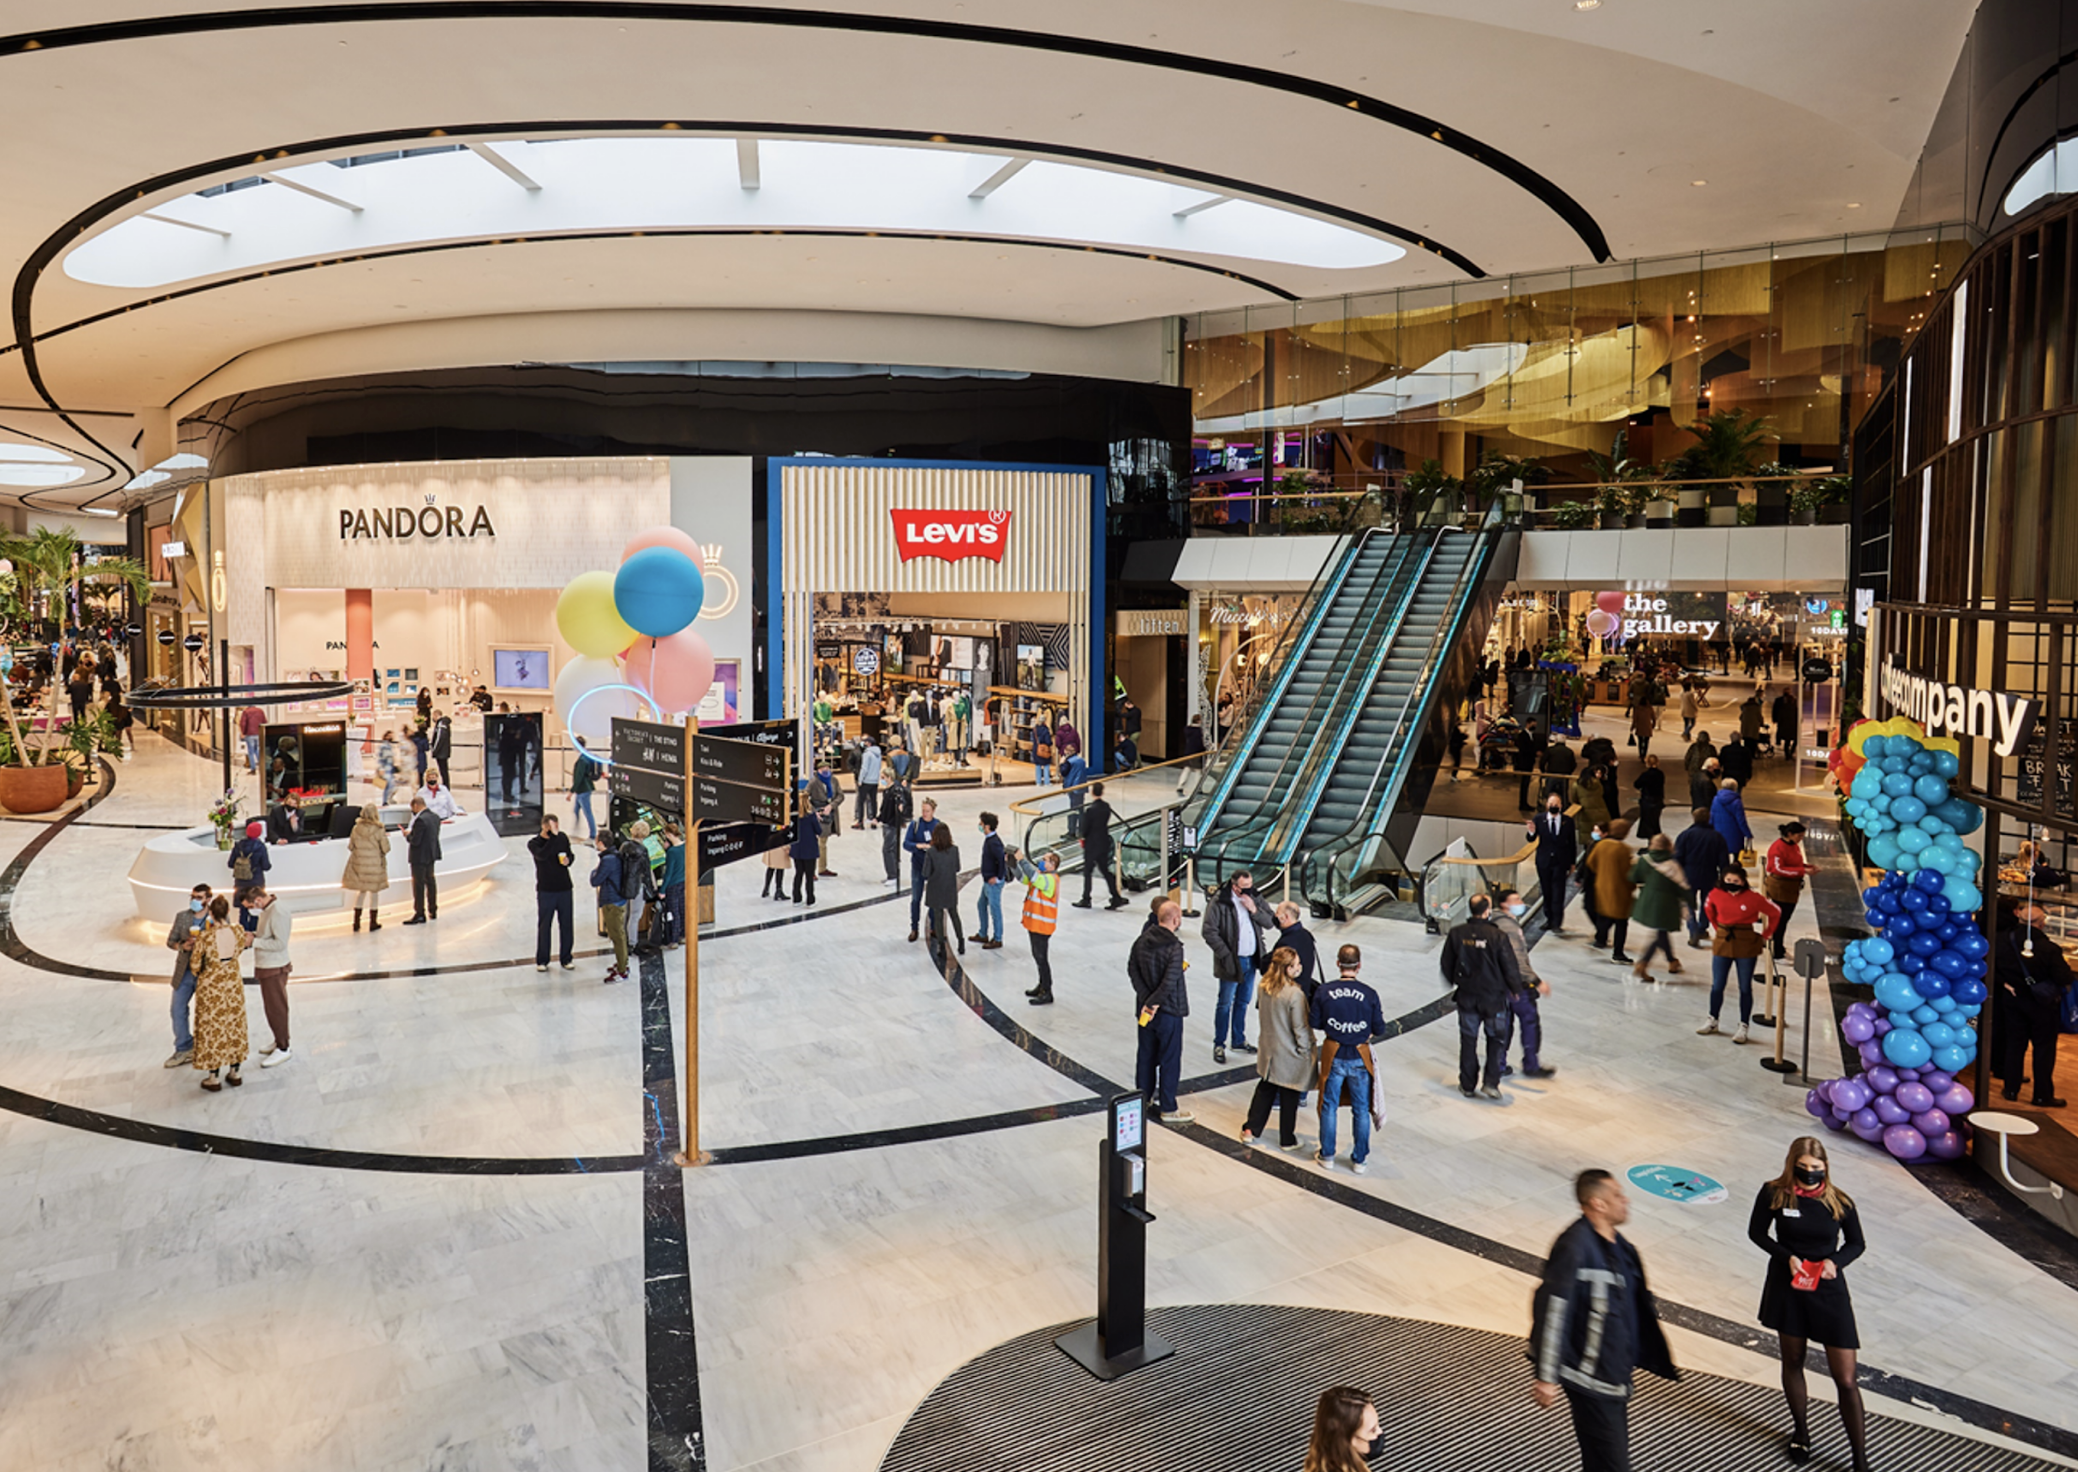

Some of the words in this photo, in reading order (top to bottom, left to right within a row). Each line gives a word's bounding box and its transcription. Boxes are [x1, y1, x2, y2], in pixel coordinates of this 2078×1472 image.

[340, 505, 495, 539] PANDORA
[1624, 593, 1667, 612] the
[1140, 618, 1179, 633] liften
[1623, 615, 1721, 640] gallery
[707, 833, 727, 842] Parking
[1328, 987, 1365, 1001] team
[1327, 1017, 1368, 1033] coffee
